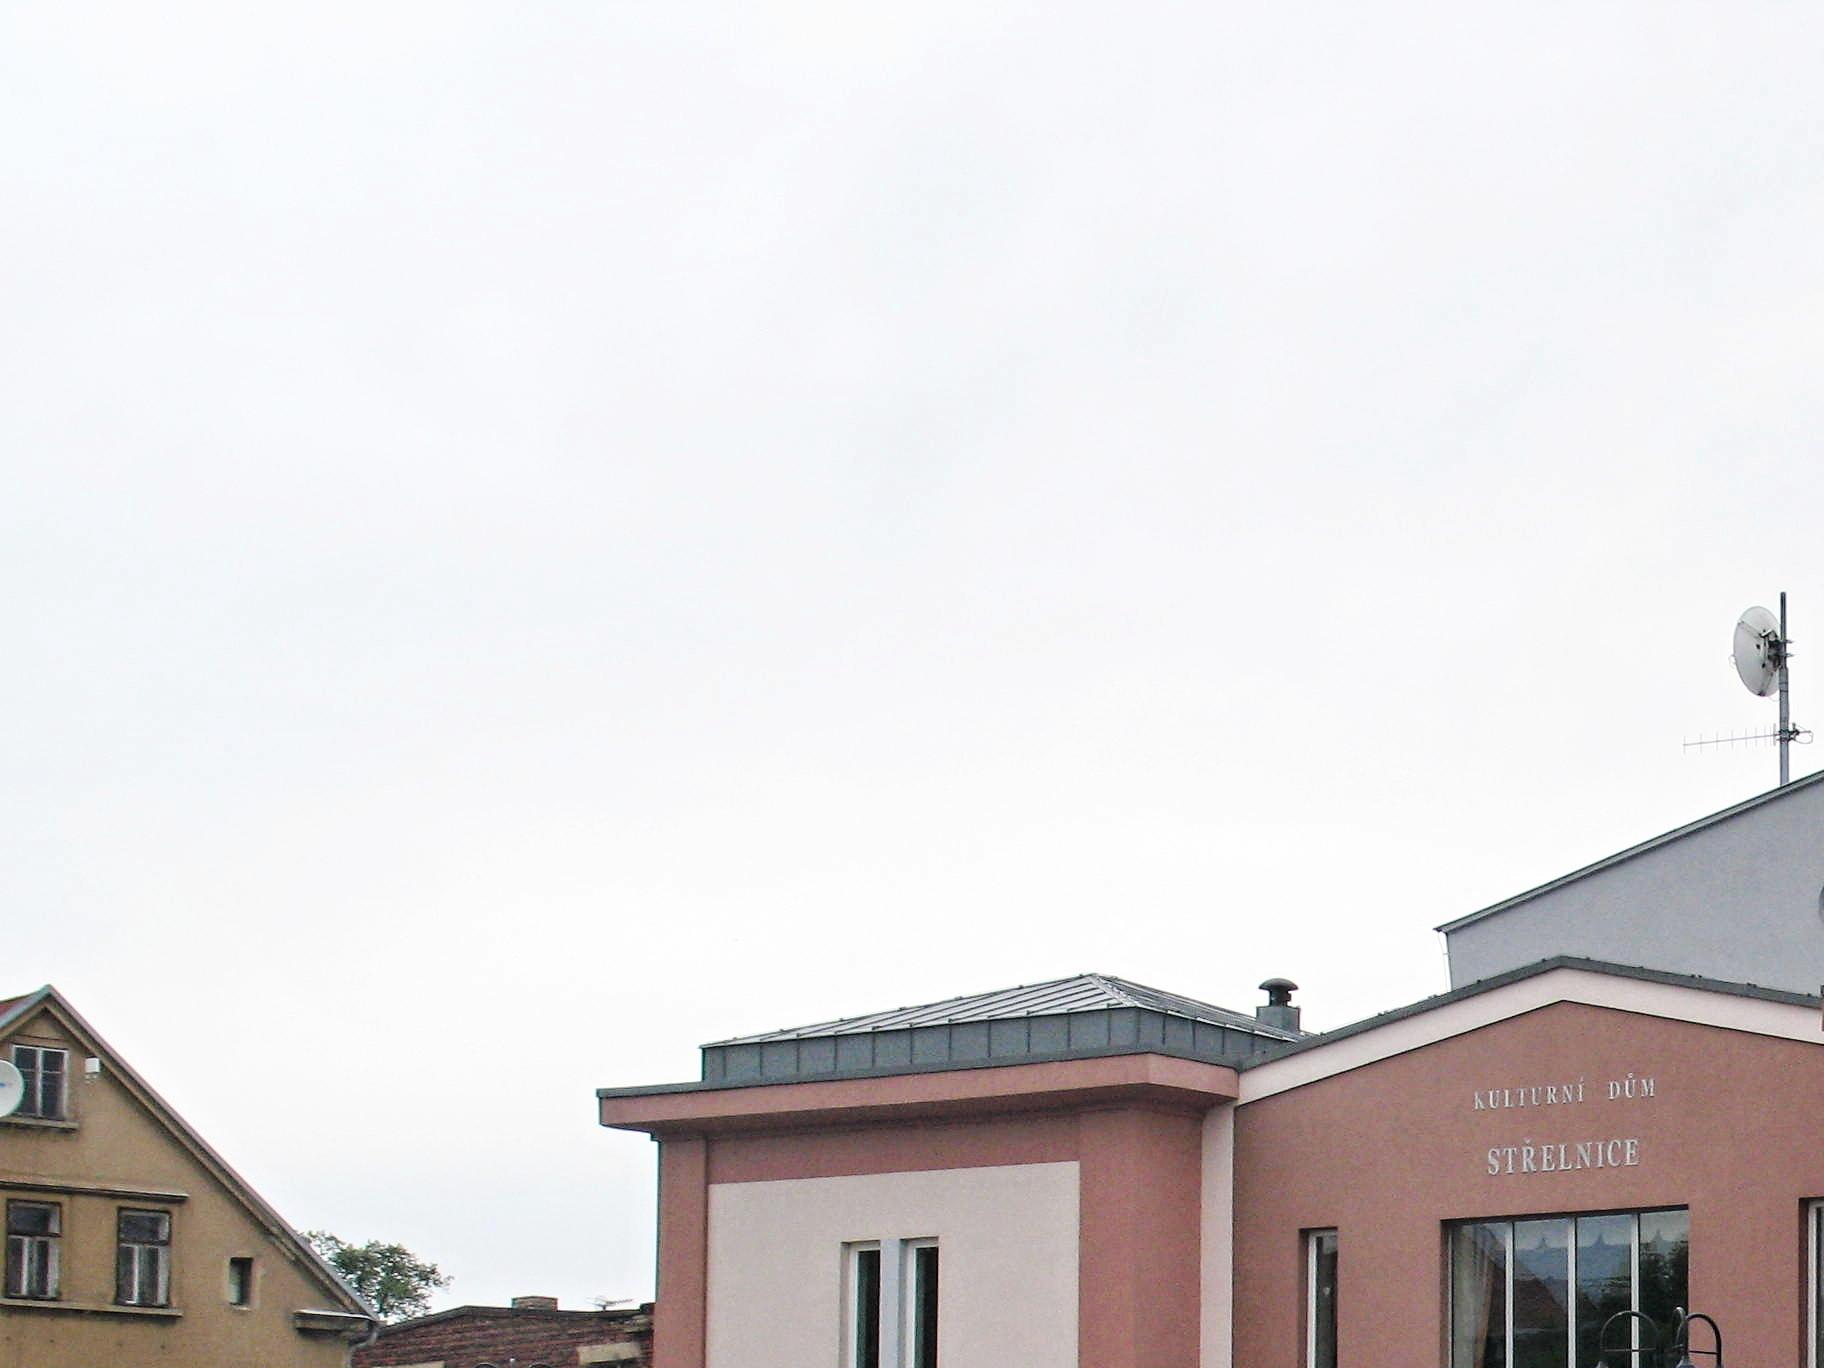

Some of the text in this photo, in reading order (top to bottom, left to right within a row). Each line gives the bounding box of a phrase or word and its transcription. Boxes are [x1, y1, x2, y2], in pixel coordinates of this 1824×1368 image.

[1473, 1072, 1657, 1112] KULTURNÍ DŮM
[1487, 1138, 1641, 1176] STŘELNICE
